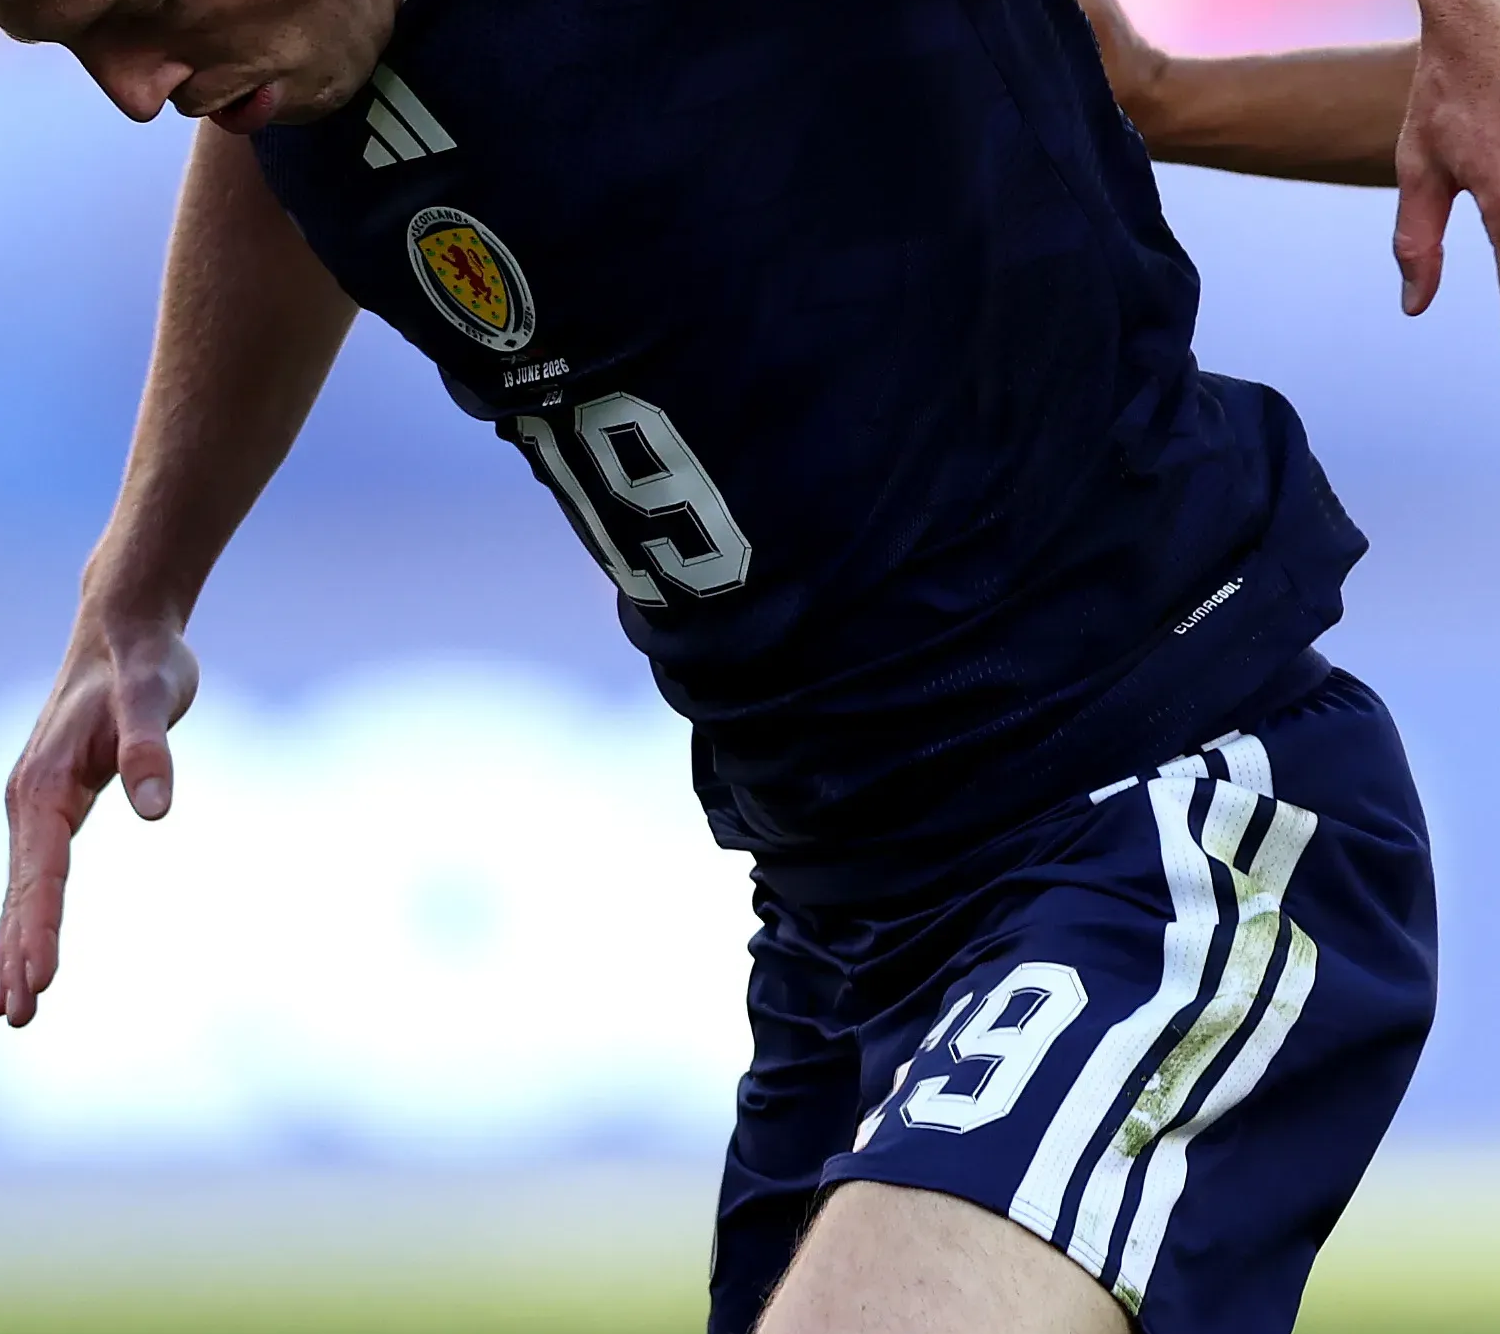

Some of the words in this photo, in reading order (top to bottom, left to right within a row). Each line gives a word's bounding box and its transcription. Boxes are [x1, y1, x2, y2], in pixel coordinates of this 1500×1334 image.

[412, 210, 462, 234] SCOTLAND
[503, 371, 514, 388] 19
[516, 364, 541, 385] JUNE
[543, 357, 570, 379] 2026
[516, 391, 752, 607] 19
